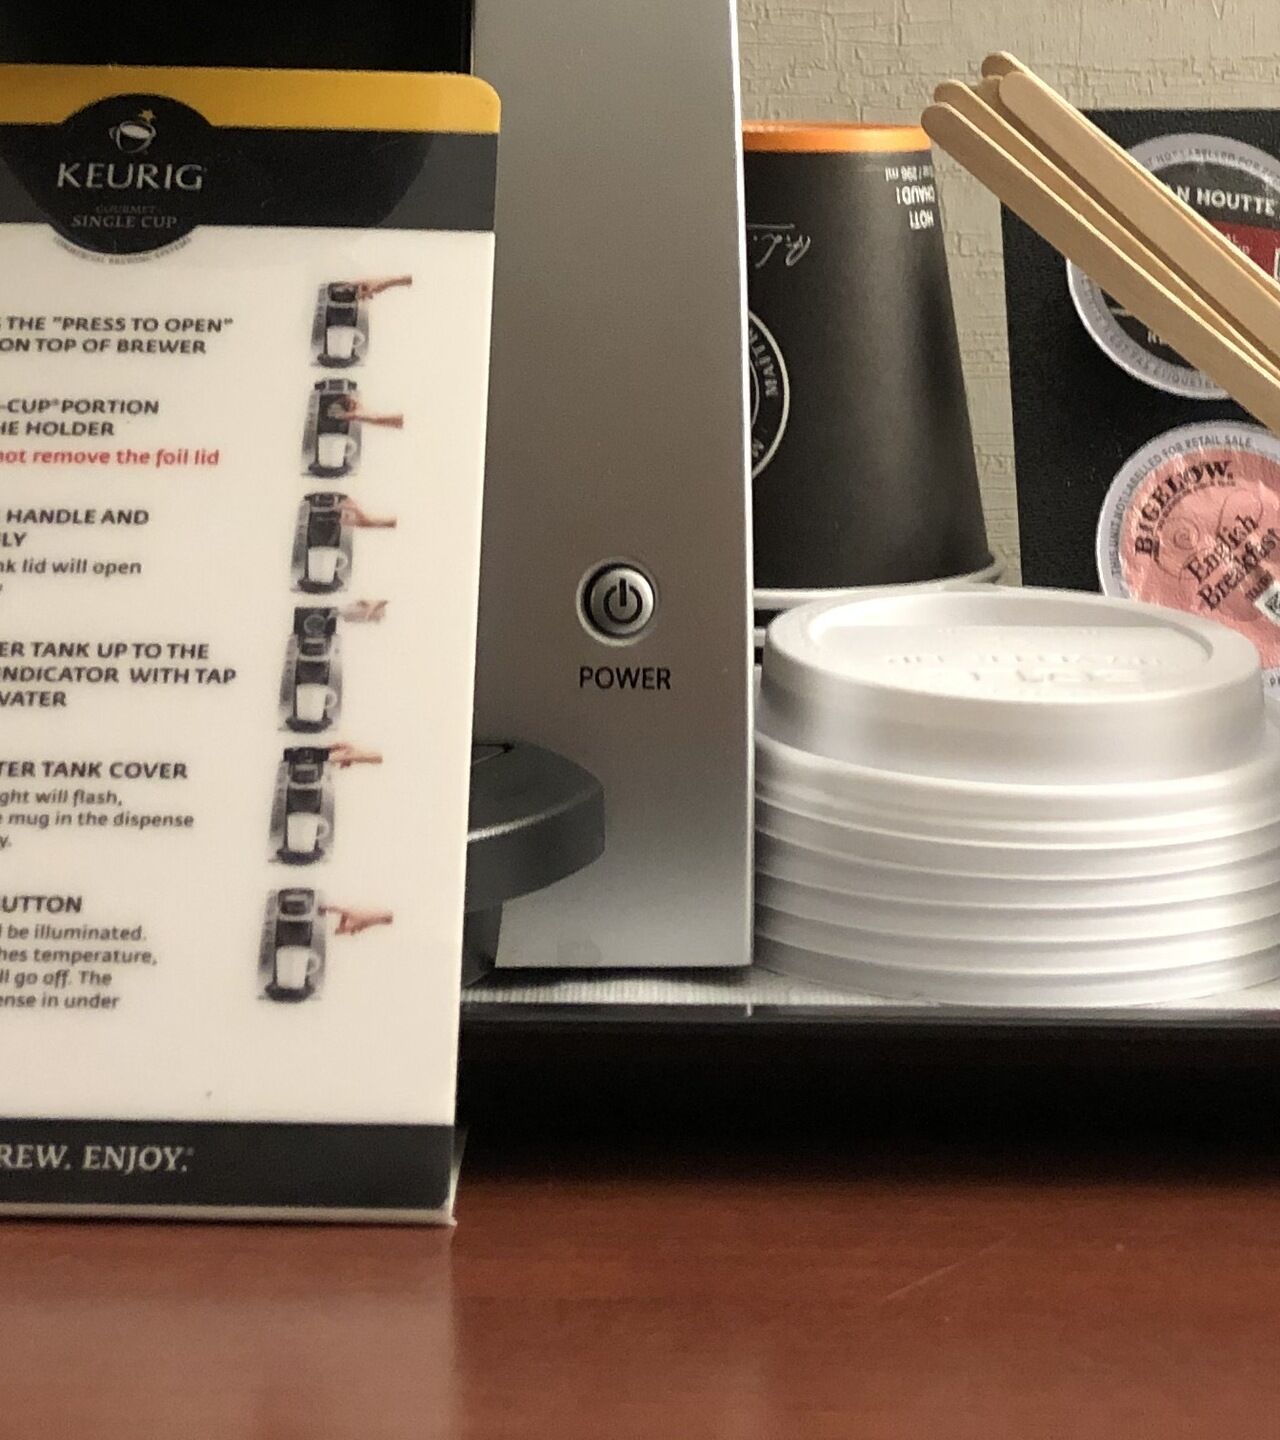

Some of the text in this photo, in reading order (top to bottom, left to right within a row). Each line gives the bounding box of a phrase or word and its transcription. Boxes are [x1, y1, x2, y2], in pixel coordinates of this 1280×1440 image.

[57, 162, 203, 191] KEURIG
[1196, 187, 1276, 217] HOUTTE
[71, 216, 178, 229] SINGLE CUP
[7, 316, 46, 331] THE
[52, 316, 126, 332] "PRESS
[132, 318, 158, 332] TO
[165, 318, 233, 333] OPEN"
[36, 338, 76, 353] TOP
[82, 339, 112, 353] OF
[117, 339, 206, 354] BREWER
[62, 399, 159, 414] PORTION
[26, 421, 114, 436] HOLDER
[33, 451, 111, 465] remove
[116, 449, 150, 465] the
[155, 449, 188, 468] foil
[194, 449, 219, 465] lid
[6, 508, 95, 524] HANDLE
[101, 509, 149, 525] AND
[1186, 514, 1259, 585] English
[22, 559, 46, 574] lid
[52, 560, 87, 575] will
[93, 561, 141, 577] open
[31, 642, 89, 658] TANK
[97, 643, 128, 659] UP
[132, 643, 162, 659] TO
[168, 643, 210, 660] THE
[130, 668, 189, 683] WITH
[196, 668, 236, 684] TAP
[579, 666, 671, 690] POWER
[42, 761, 101, 779] TANK
[110, 762, 188, 780] COVER
[36, 788, 68, 804] will
[73, 788, 123, 806] flash,
[9, 814, 49, 829] mug
[55, 811, 72, 826] in
[78, 812, 107, 826] the
[113, 811, 194, 829] dispense
[8, 924, 29, 939] be
[34, 924, 146, 941] illuminated.
[33, 949, 158, 965] temperature,
[14, 973, 37, 987] go
[43, 970, 71, 988] off.
[78, 971, 112, 986] The
[42, 993, 58, 1007] in
[64, 993, 119, 1009] under
[82, 1146, 188, 1175] ENJOY.
